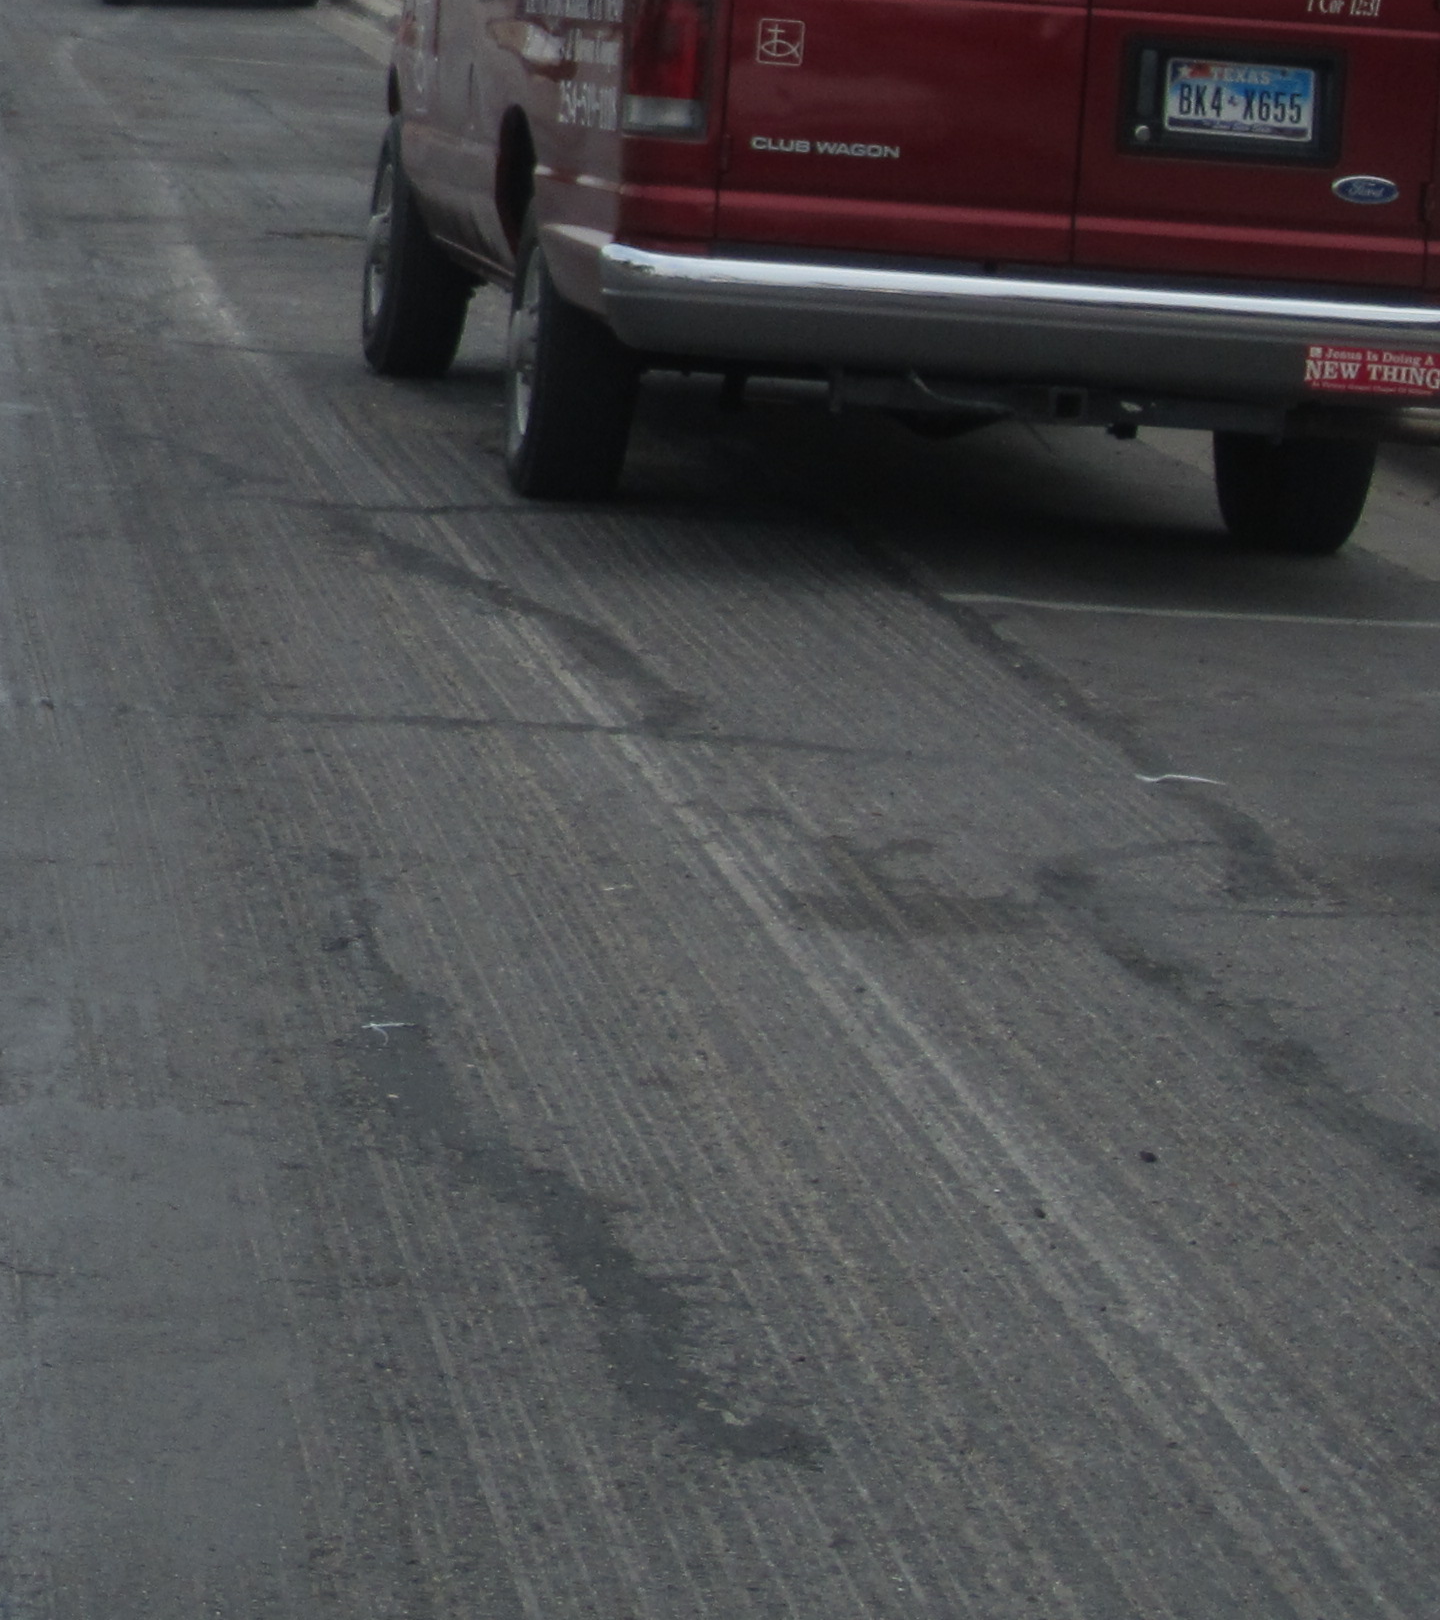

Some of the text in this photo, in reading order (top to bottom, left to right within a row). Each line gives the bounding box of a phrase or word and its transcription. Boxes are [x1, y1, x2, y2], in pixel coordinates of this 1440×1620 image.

[752, 136, 901, 158] CLUB WAGON
[1325, 349, 1434, 366] Jesus Is Doing A
[1304, 359, 1440, 389] NEW THING
